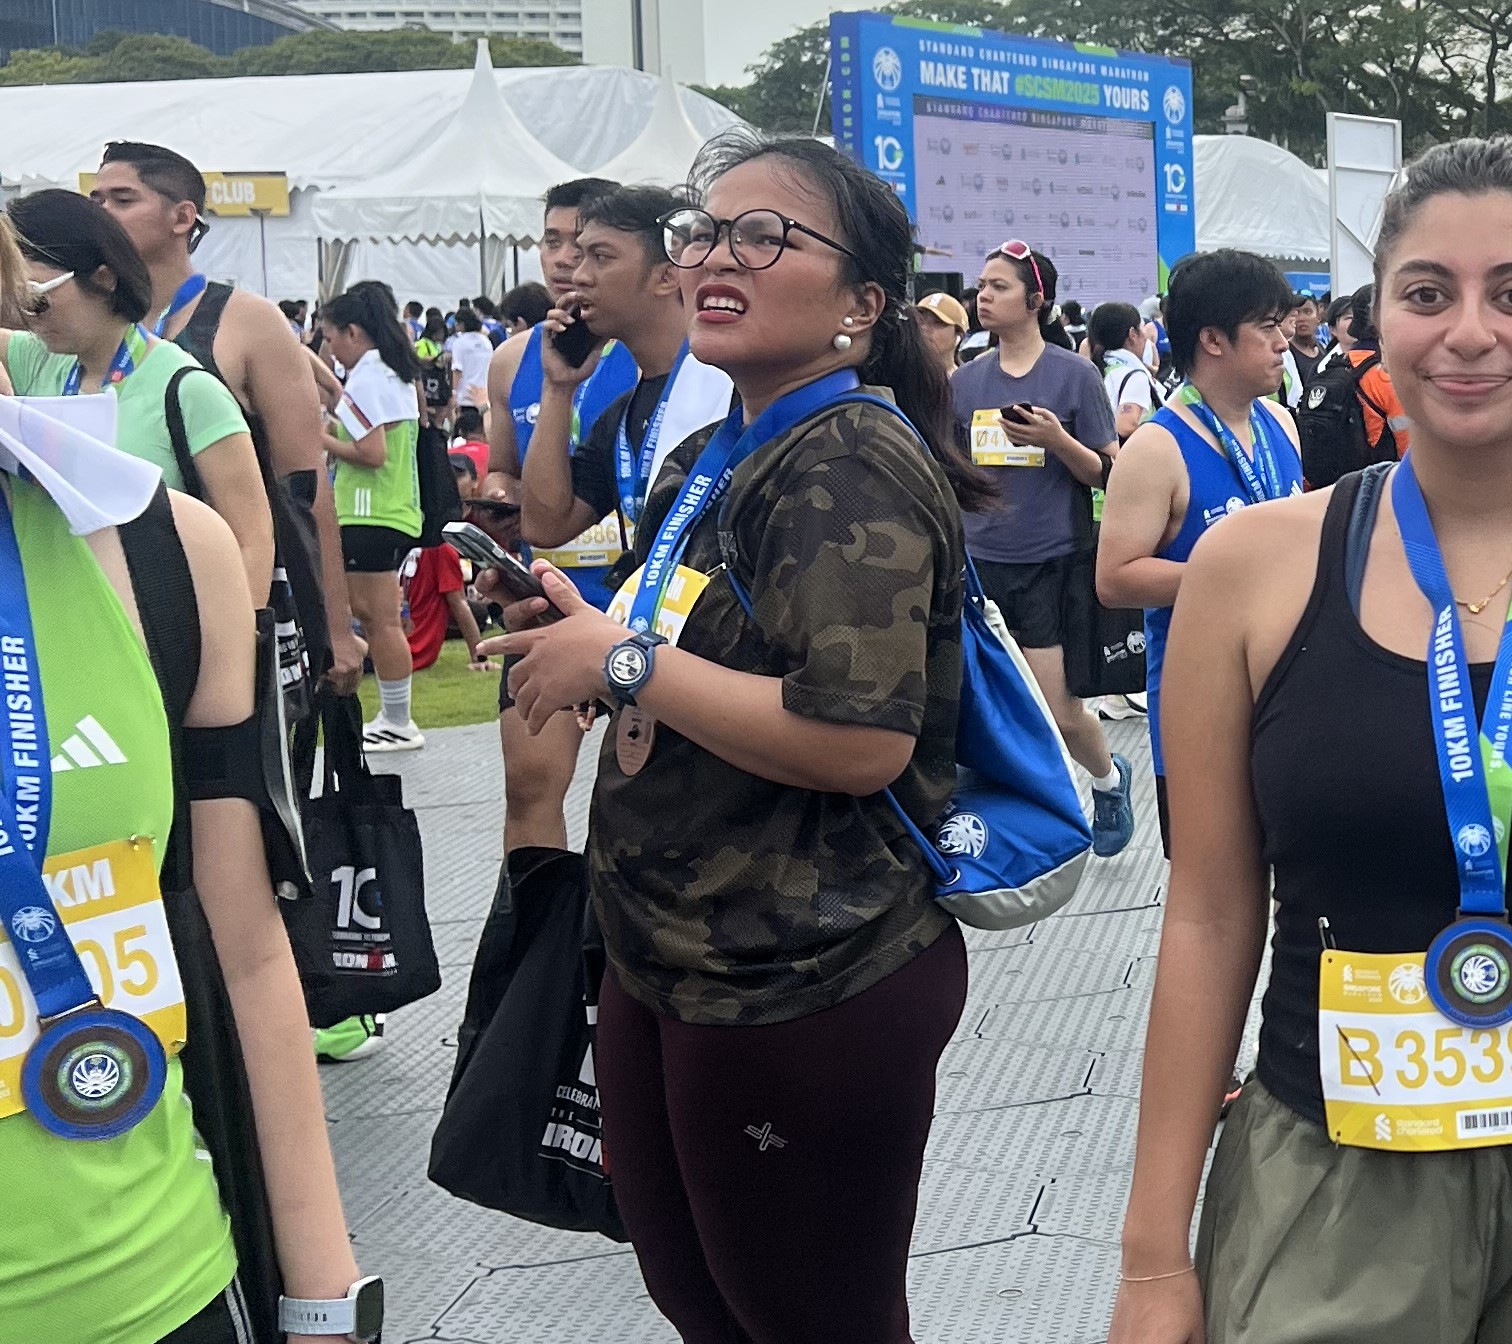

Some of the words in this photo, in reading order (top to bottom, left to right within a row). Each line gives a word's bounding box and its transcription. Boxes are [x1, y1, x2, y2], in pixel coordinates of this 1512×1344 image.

[919, 39, 975, 59] STANDARD
[979, 47, 1038, 68] CHARTERED
[1041, 56, 1097, 76] SINGAPORE
[1100, 65, 1149, 83] MARATHON
[920, 59, 967, 90] MAKE
[971, 66, 1010, 95] THAT
[1015, 74, 1099, 106] #SCSM2025
[1103, 83, 1149, 112] YOURS
[211, 181, 256, 205] CLUB
[645, 543, 671, 589] 10KM
[661, 474, 713, 541] FINISHER
[1434, 604, 1463, 713] FINISHER
[1, 635, 40, 767] FINISHER
[1442, 715, 1475, 783] 10KM
[16, 775, 41, 851] 0KM
